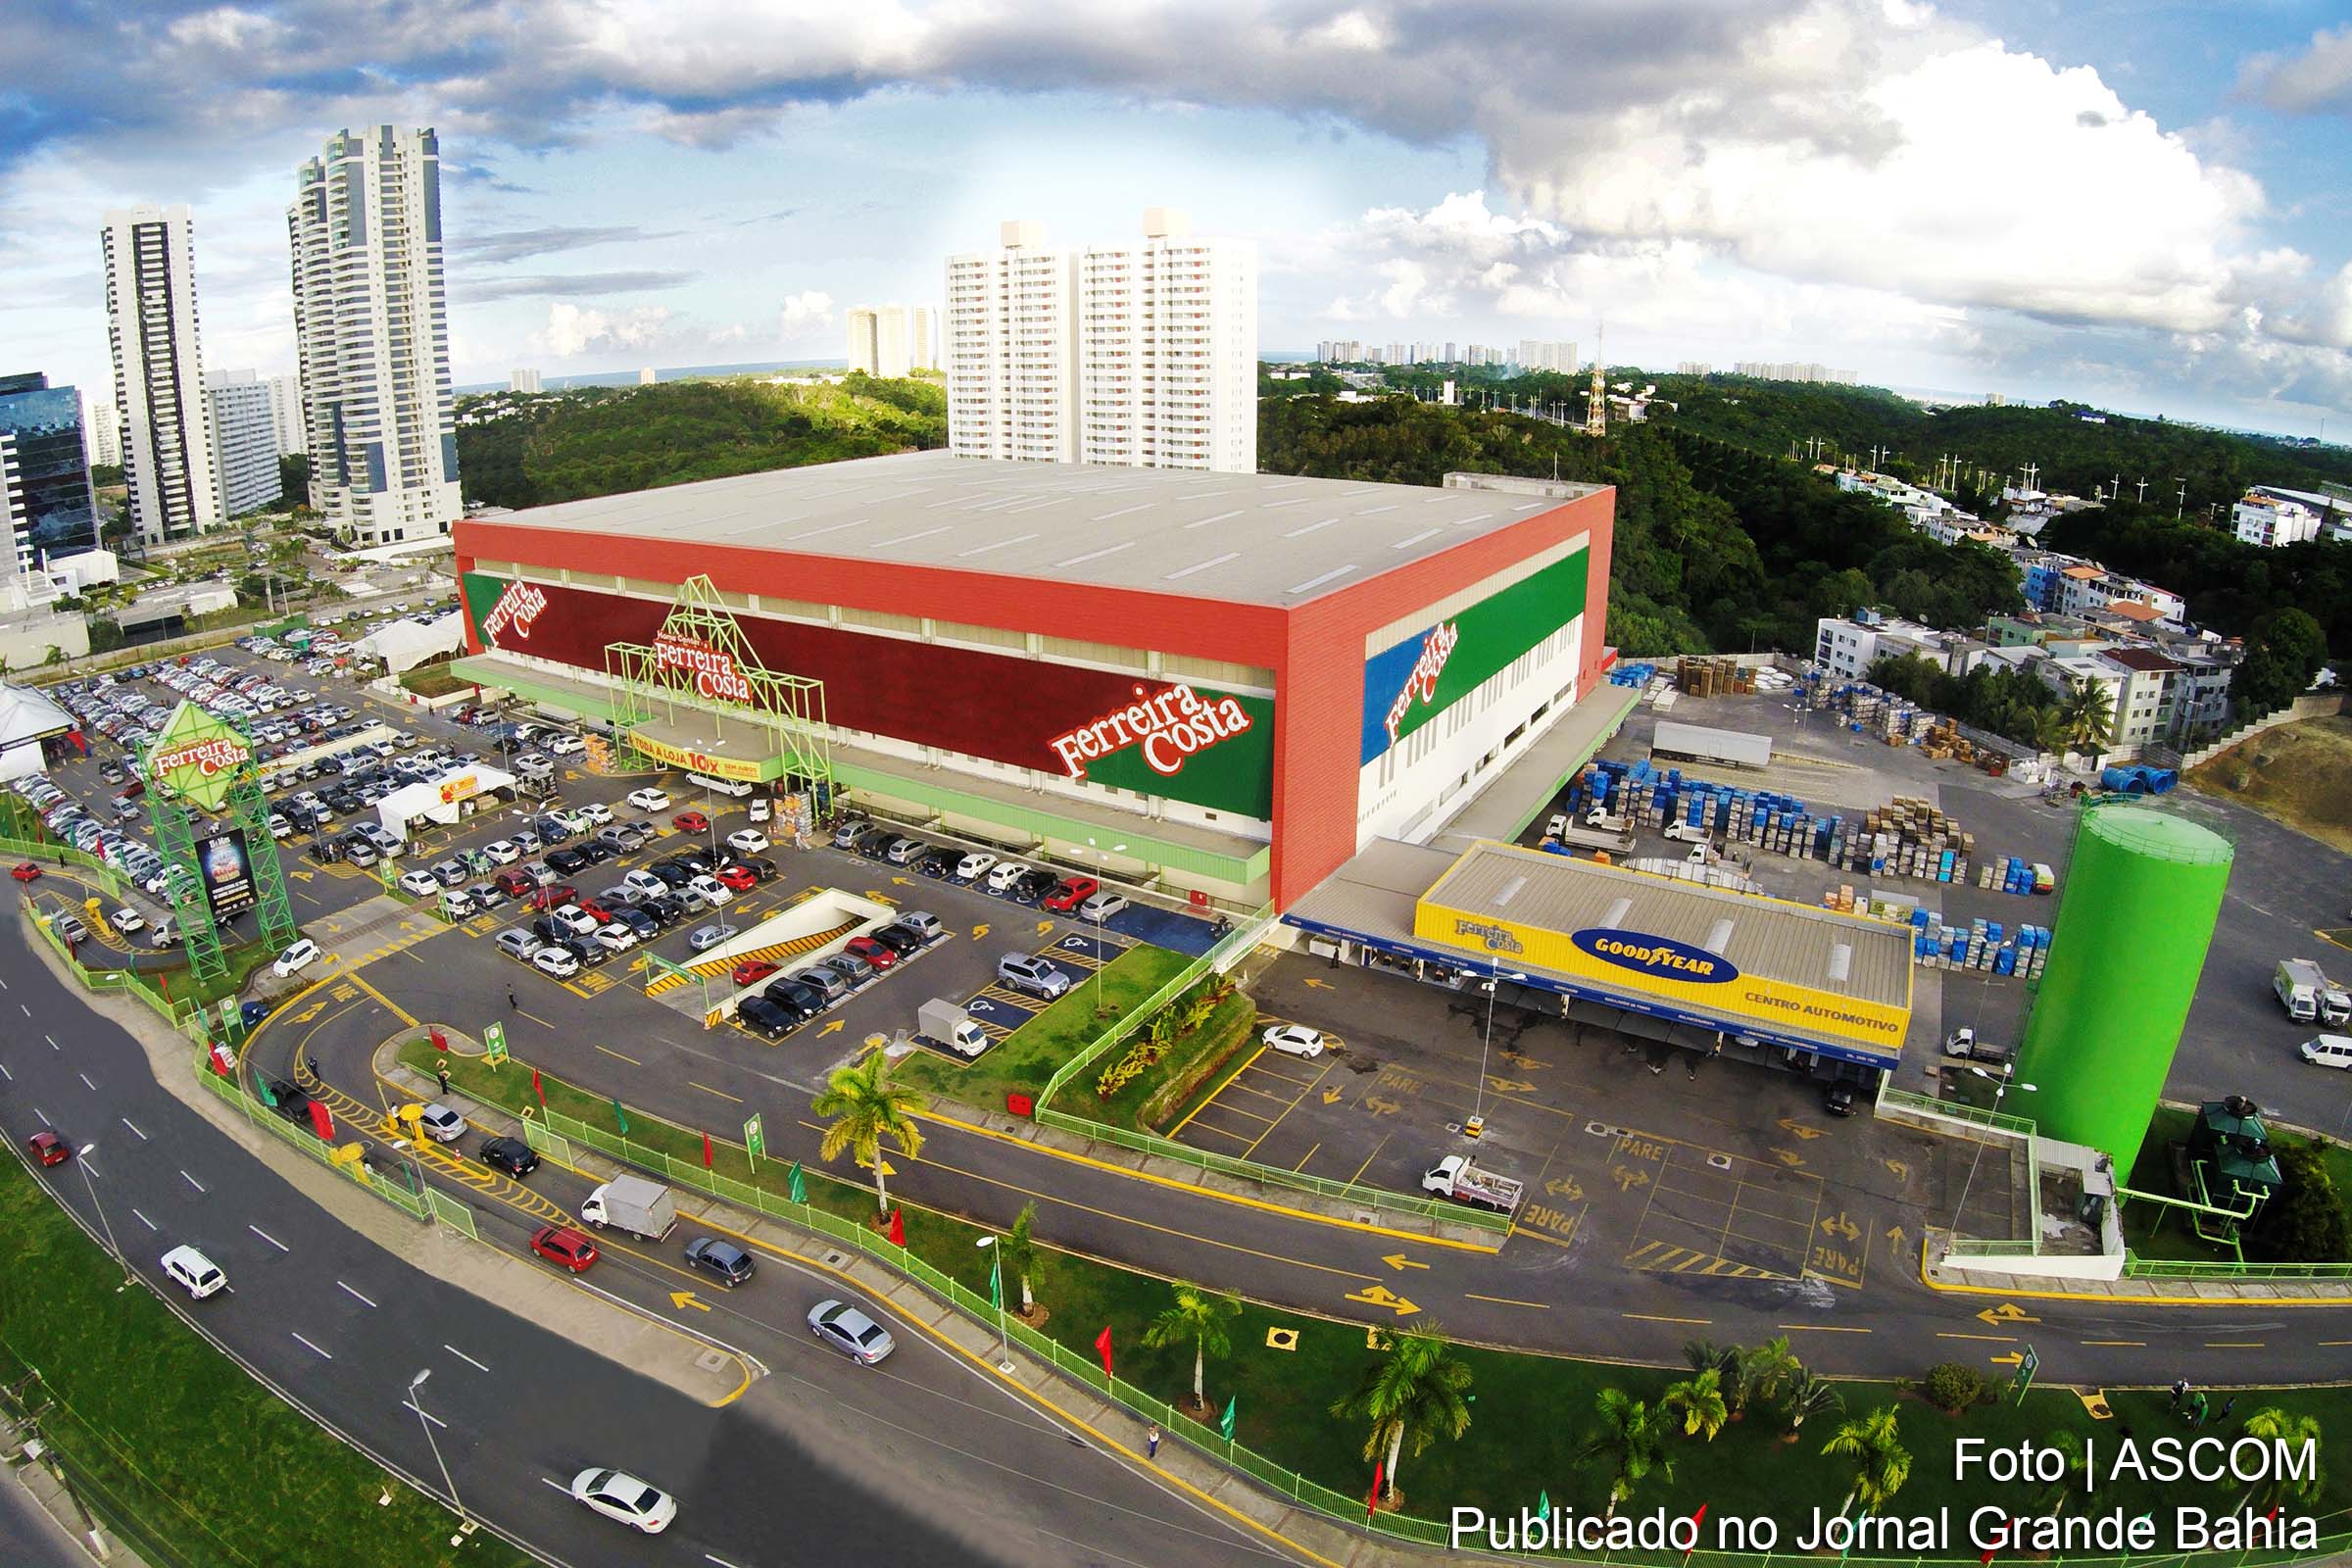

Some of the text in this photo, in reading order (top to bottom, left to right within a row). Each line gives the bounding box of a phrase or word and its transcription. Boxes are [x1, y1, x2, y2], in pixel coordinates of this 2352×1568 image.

[483, 580, 528, 648] Ferreira
[514, 587, 547, 638] Costa
[654, 642, 732, 676] Ferreira
[1422, 622, 1458, 703] Costa
[697, 671, 750, 700] Costa
[1386, 622, 1445, 748] Ferreira
[1052, 683, 1202, 779] Ferreira
[1144, 699, 1250, 772] Costa
[155, 737, 232, 777] Ferreira
[199, 747, 249, 777] Costa
[1456, 920, 1513, 942] Ferreira
[1486, 937, 1523, 953] Costa
[1594, 938, 1715, 976] GOODYEAR
[1744, 991, 1899, 1033] CENTRO AUTOMOTIVO
[1617, 1137, 1663, 1161] PARE
[1524, 1203, 1575, 1235] PARE
[1812, 1246, 1860, 1276] PARE
